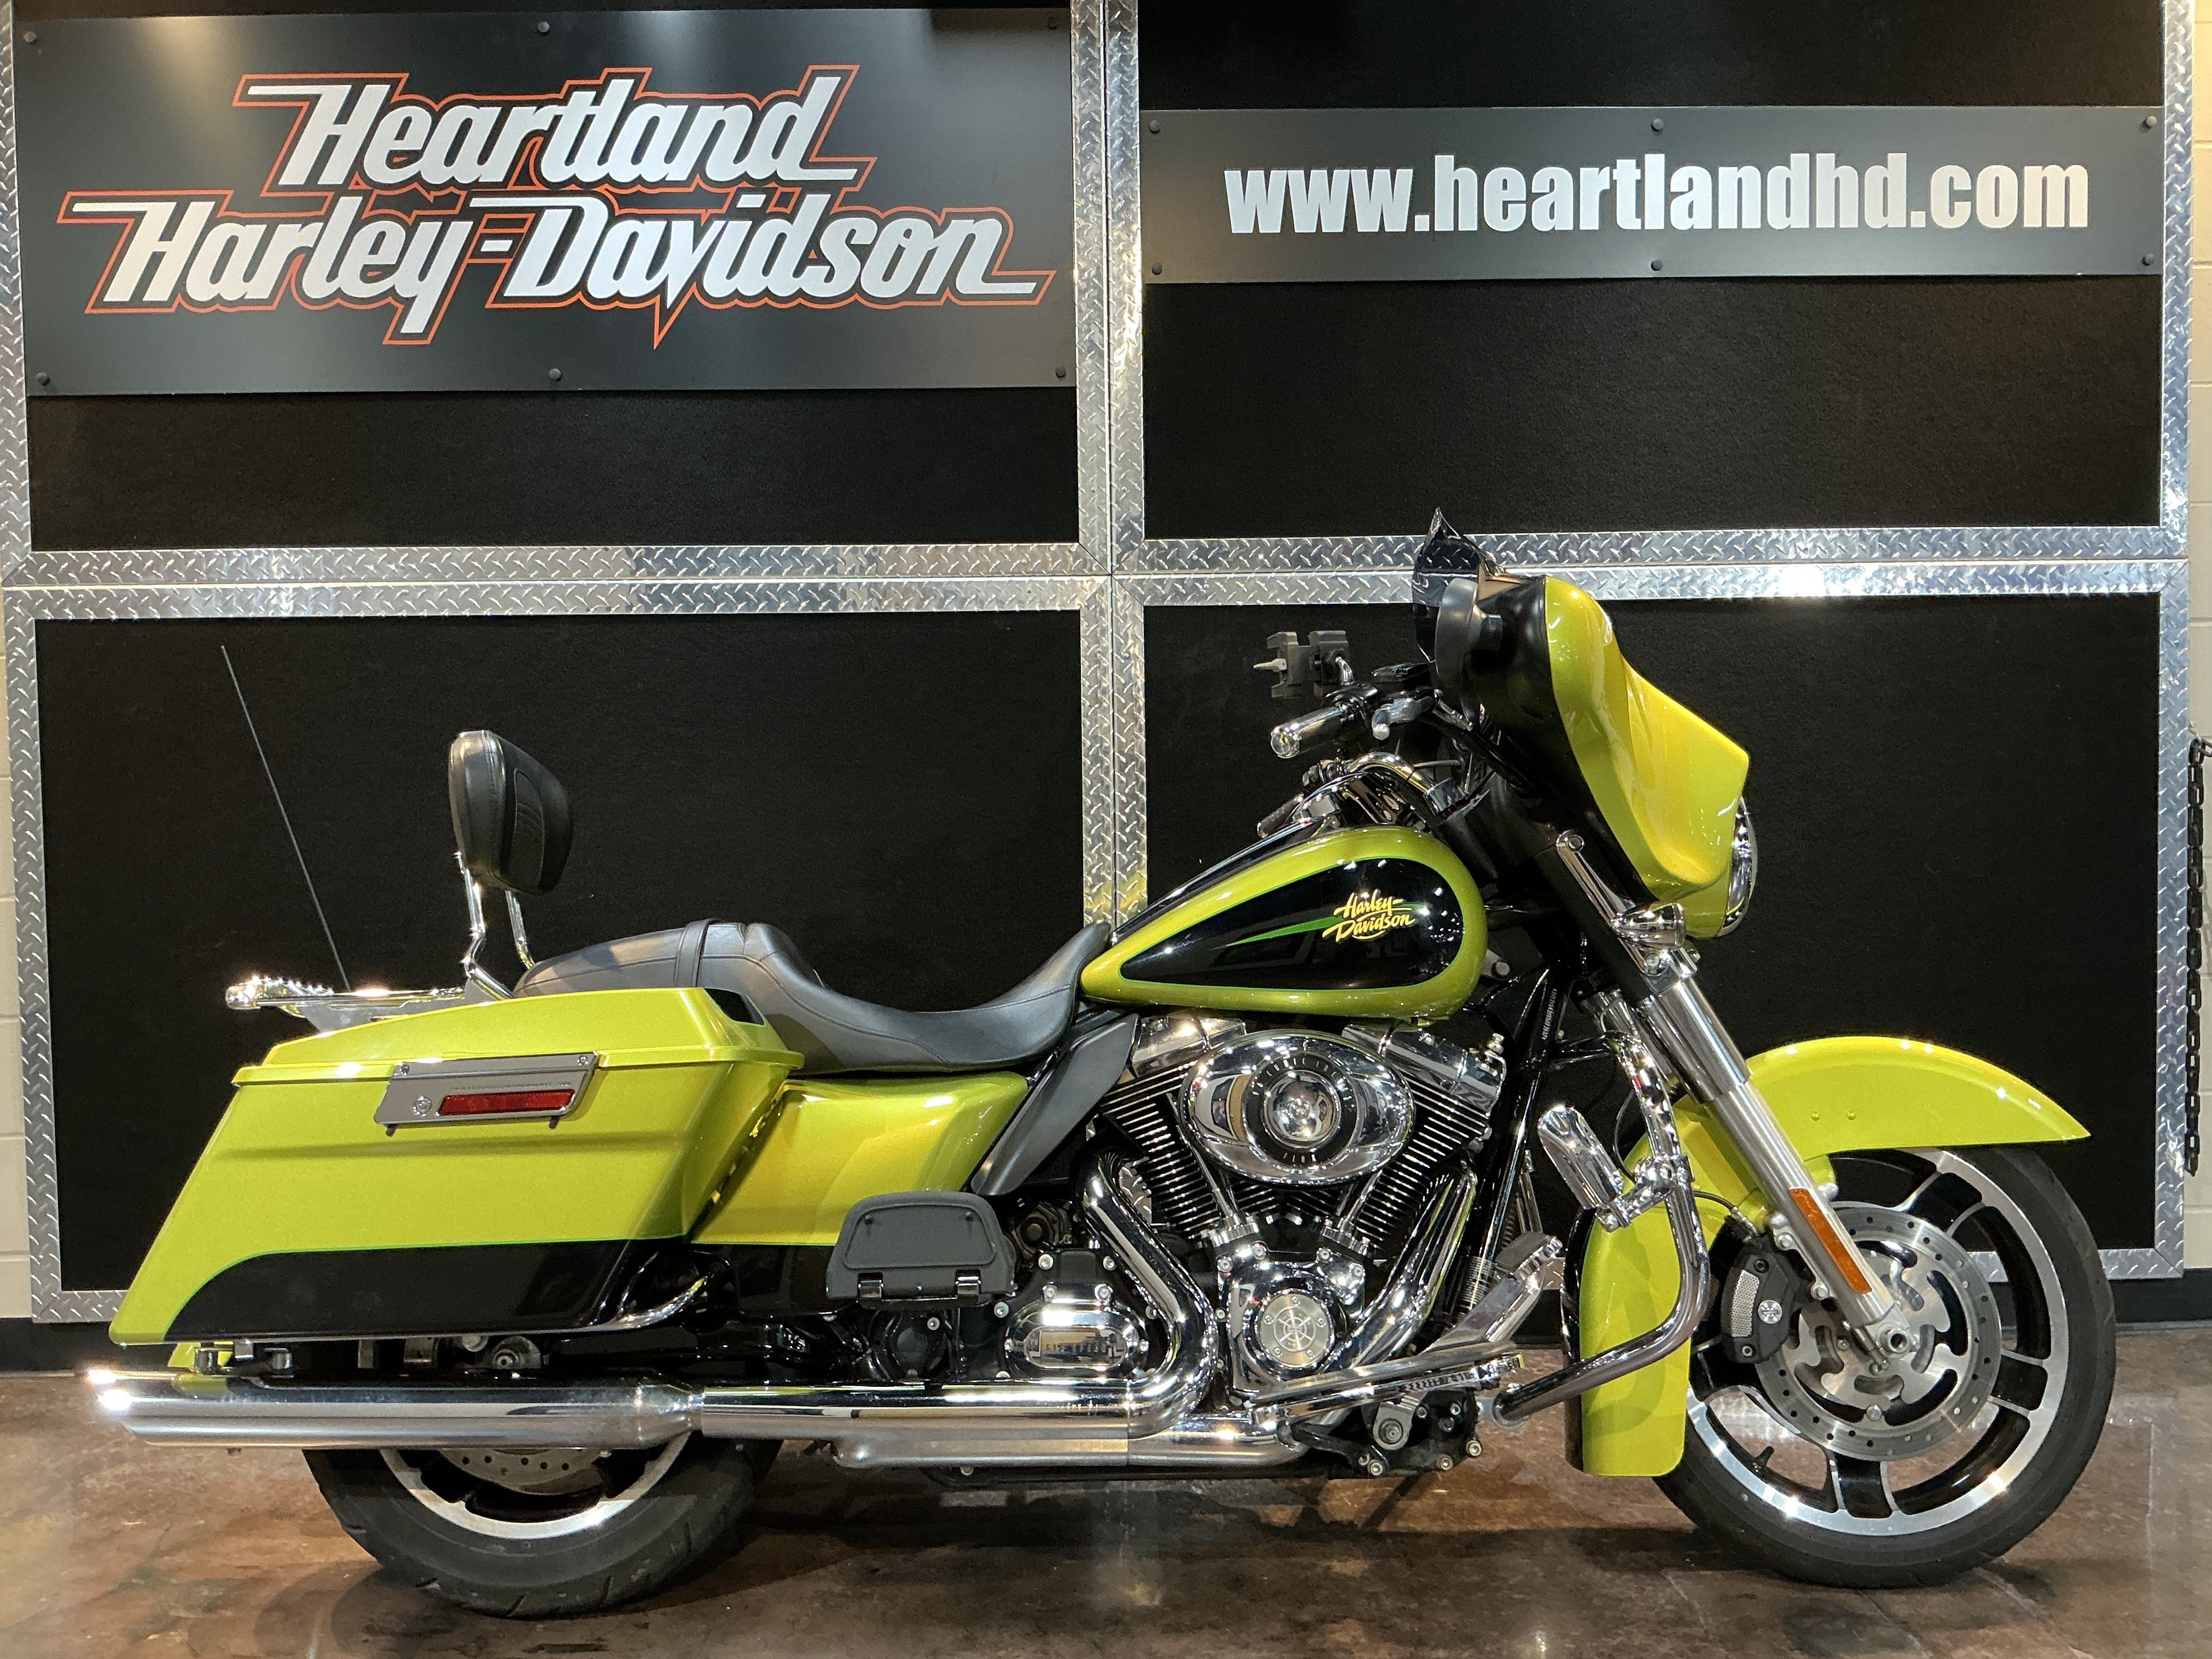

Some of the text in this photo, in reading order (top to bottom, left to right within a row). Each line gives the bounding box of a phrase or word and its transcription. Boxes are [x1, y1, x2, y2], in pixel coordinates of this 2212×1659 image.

[247, 76, 859, 187] Heartland
[1223, 152, 2089, 234] www.heartlandhd.com
[72, 194, 1038, 334] Harley-Davidson
[1322, 912, 1416, 943] Davidson
